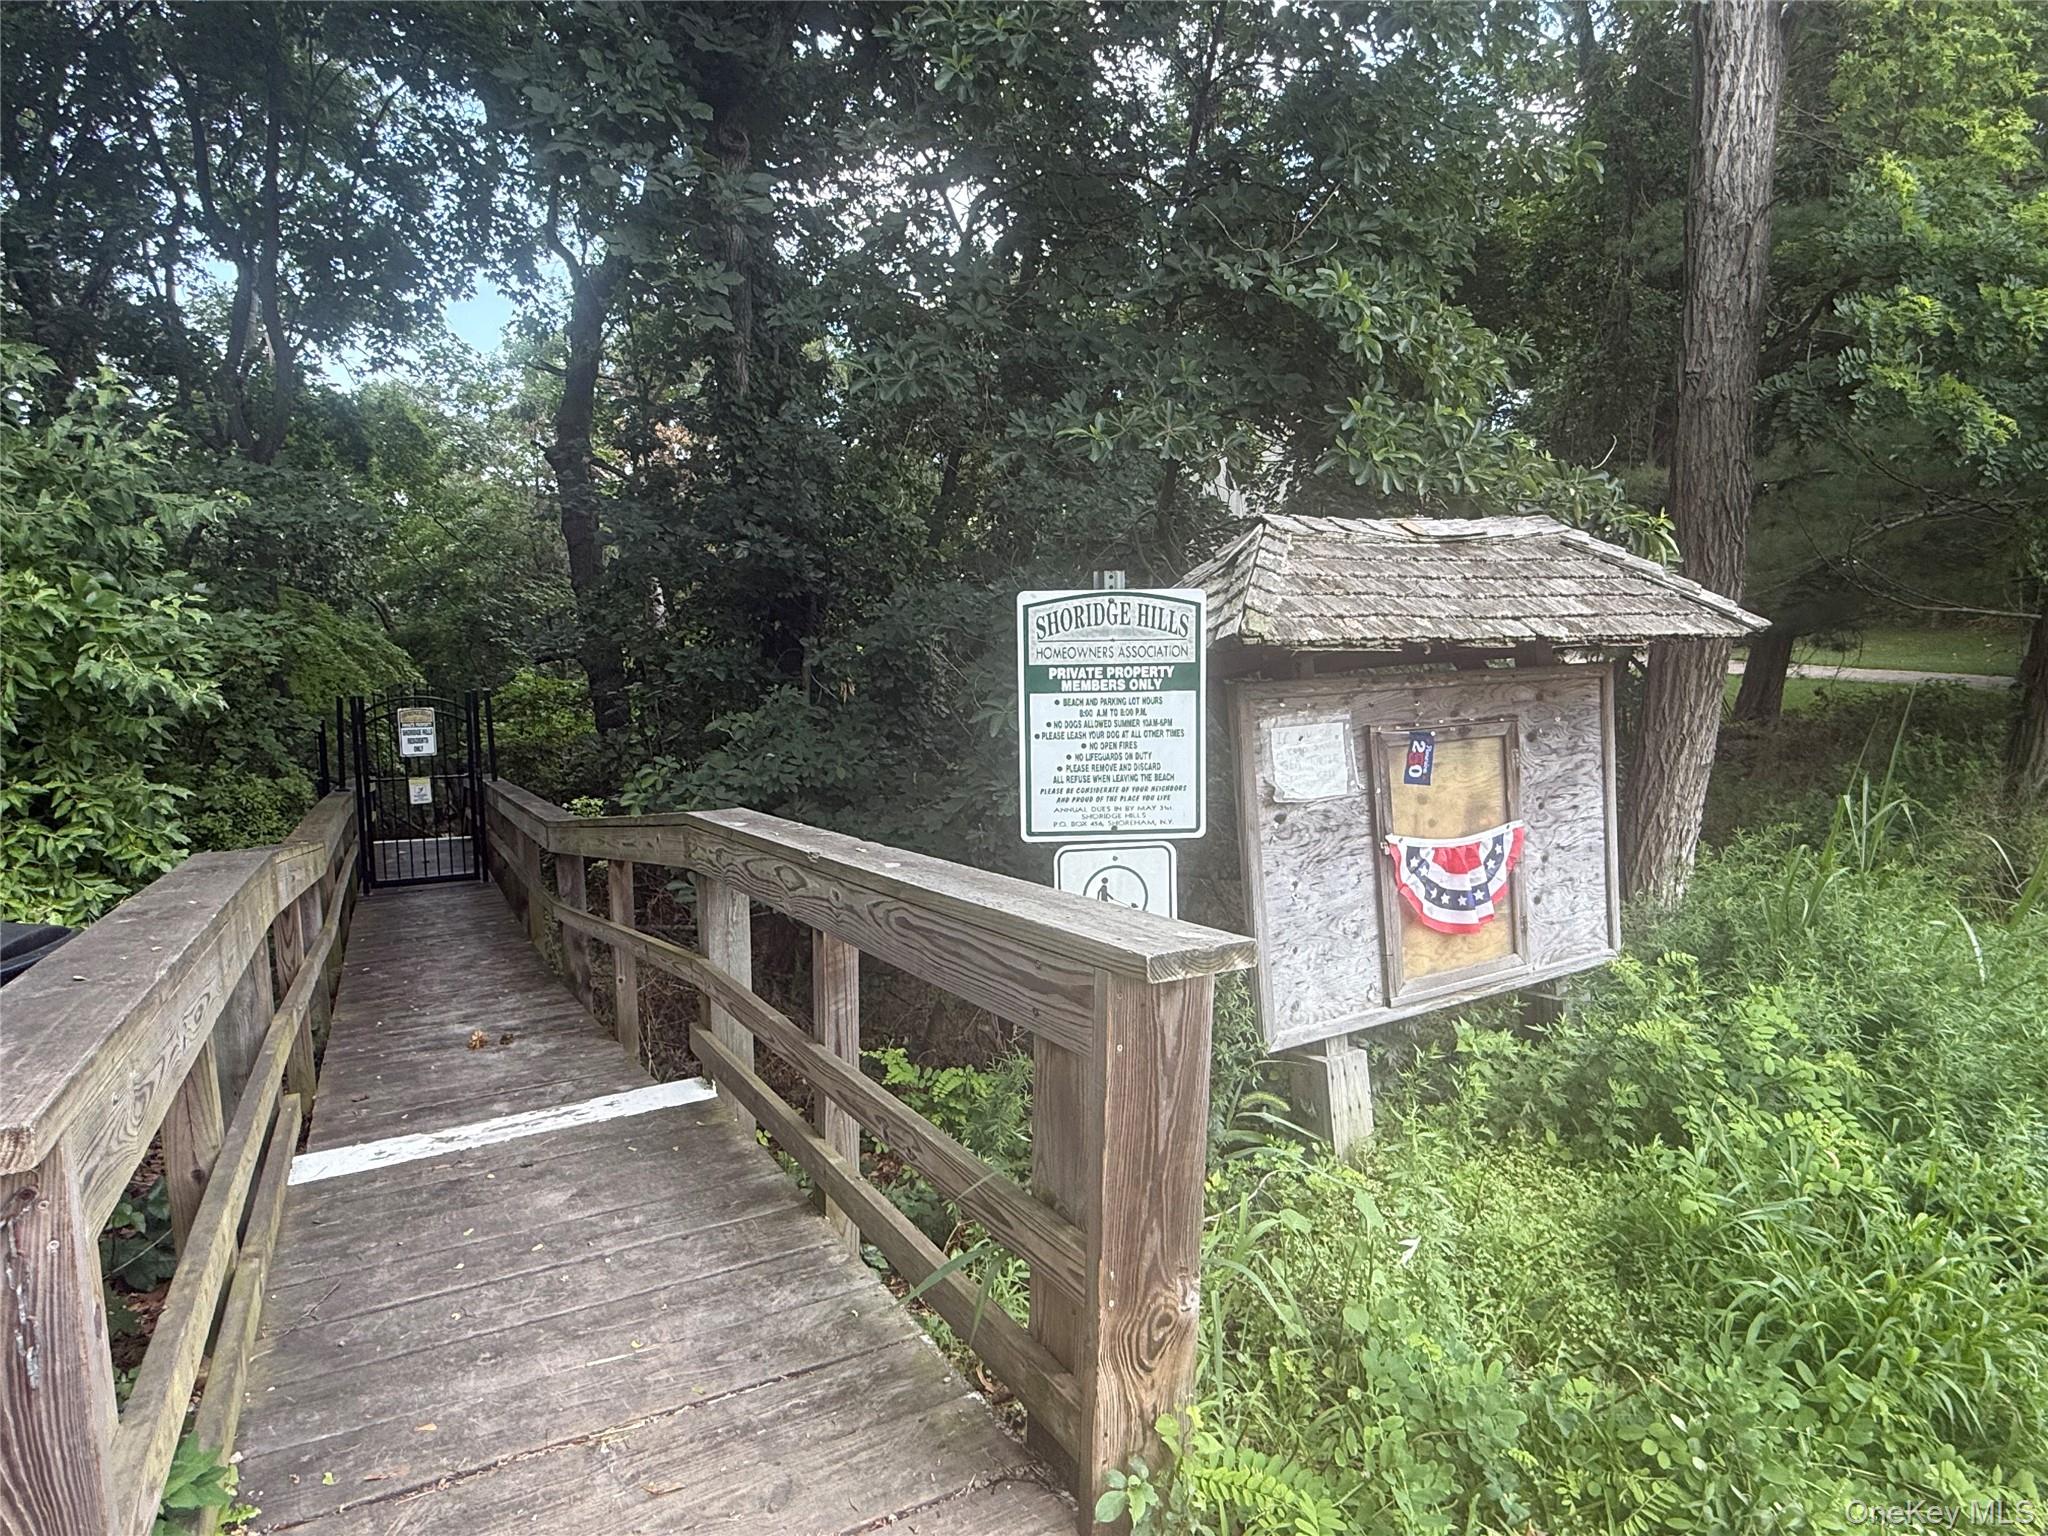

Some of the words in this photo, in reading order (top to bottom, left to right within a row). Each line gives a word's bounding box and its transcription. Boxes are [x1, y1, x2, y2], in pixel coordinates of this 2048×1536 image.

[1036, 601, 1131, 640] SHORIDGE
[1137, 603, 1189, 638] HILLS
[1036, 646, 1114, 659] HOMEOWNERS
[1118, 645, 1189, 657] ASSOCIATION
[1049, 667, 1104, 680] PRIVATE
[1107, 666, 1175, 679] PROPERTY
[1061, 680, 1125, 692] MEMBERS
[1129, 679, 1163, 690] ONLY
[1063, 698, 1084, 707] BEACH
[1085, 698, 1098, 706] AND
[1100, 697, 1126, 706] PARKING
[1128, 697, 1140, 705] LOT
[1142, 696, 1163, 705] HOURS
[1110, 708, 1118, 717] TO
[1053, 720, 1063, 728] NO
[1065, 720, 1082, 728] DOGS
[1084, 720, 1112, 728] ALLOWED
[1114, 719, 1140, 727] SUMMER
[1042, 732, 1065, 740] PLEASE
[1067, 731, 1086, 739] LEASH
[1089, 731, 1105, 739] YOUR
[1107, 731, 1120, 739] DOG
[1131, 730, 1142, 738] ALL
[1144, 730, 1164, 738] OTHER
[1166, 729, 1185, 738] TIMES
[1089, 742, 1099, 750] NO
[1100, 742, 1117, 750] OPEN
[1119, 741, 1138, 749] FIRES
[1075, 753, 1083, 761] NO
[1085, 753, 1123, 761] LIFEGUARDS
[1135, 752, 1152, 760] DUTY
[1066, 764, 1089, 772] PLEASE
[1091, 764, 1118, 772] REMOVE
[1119, 763, 1132, 771] AND
[1133, 763, 1161, 771] DISCARD
[1053, 776, 1064, 784] ALL
[1066, 775, 1091, 784] REFUSE
[1093, 775, 1111, 783] WHEN
[1113, 774, 1139, 783] LEAVING
[1140, 774, 1153, 782] THE
[1154, 773, 1175, 782] BEACH
